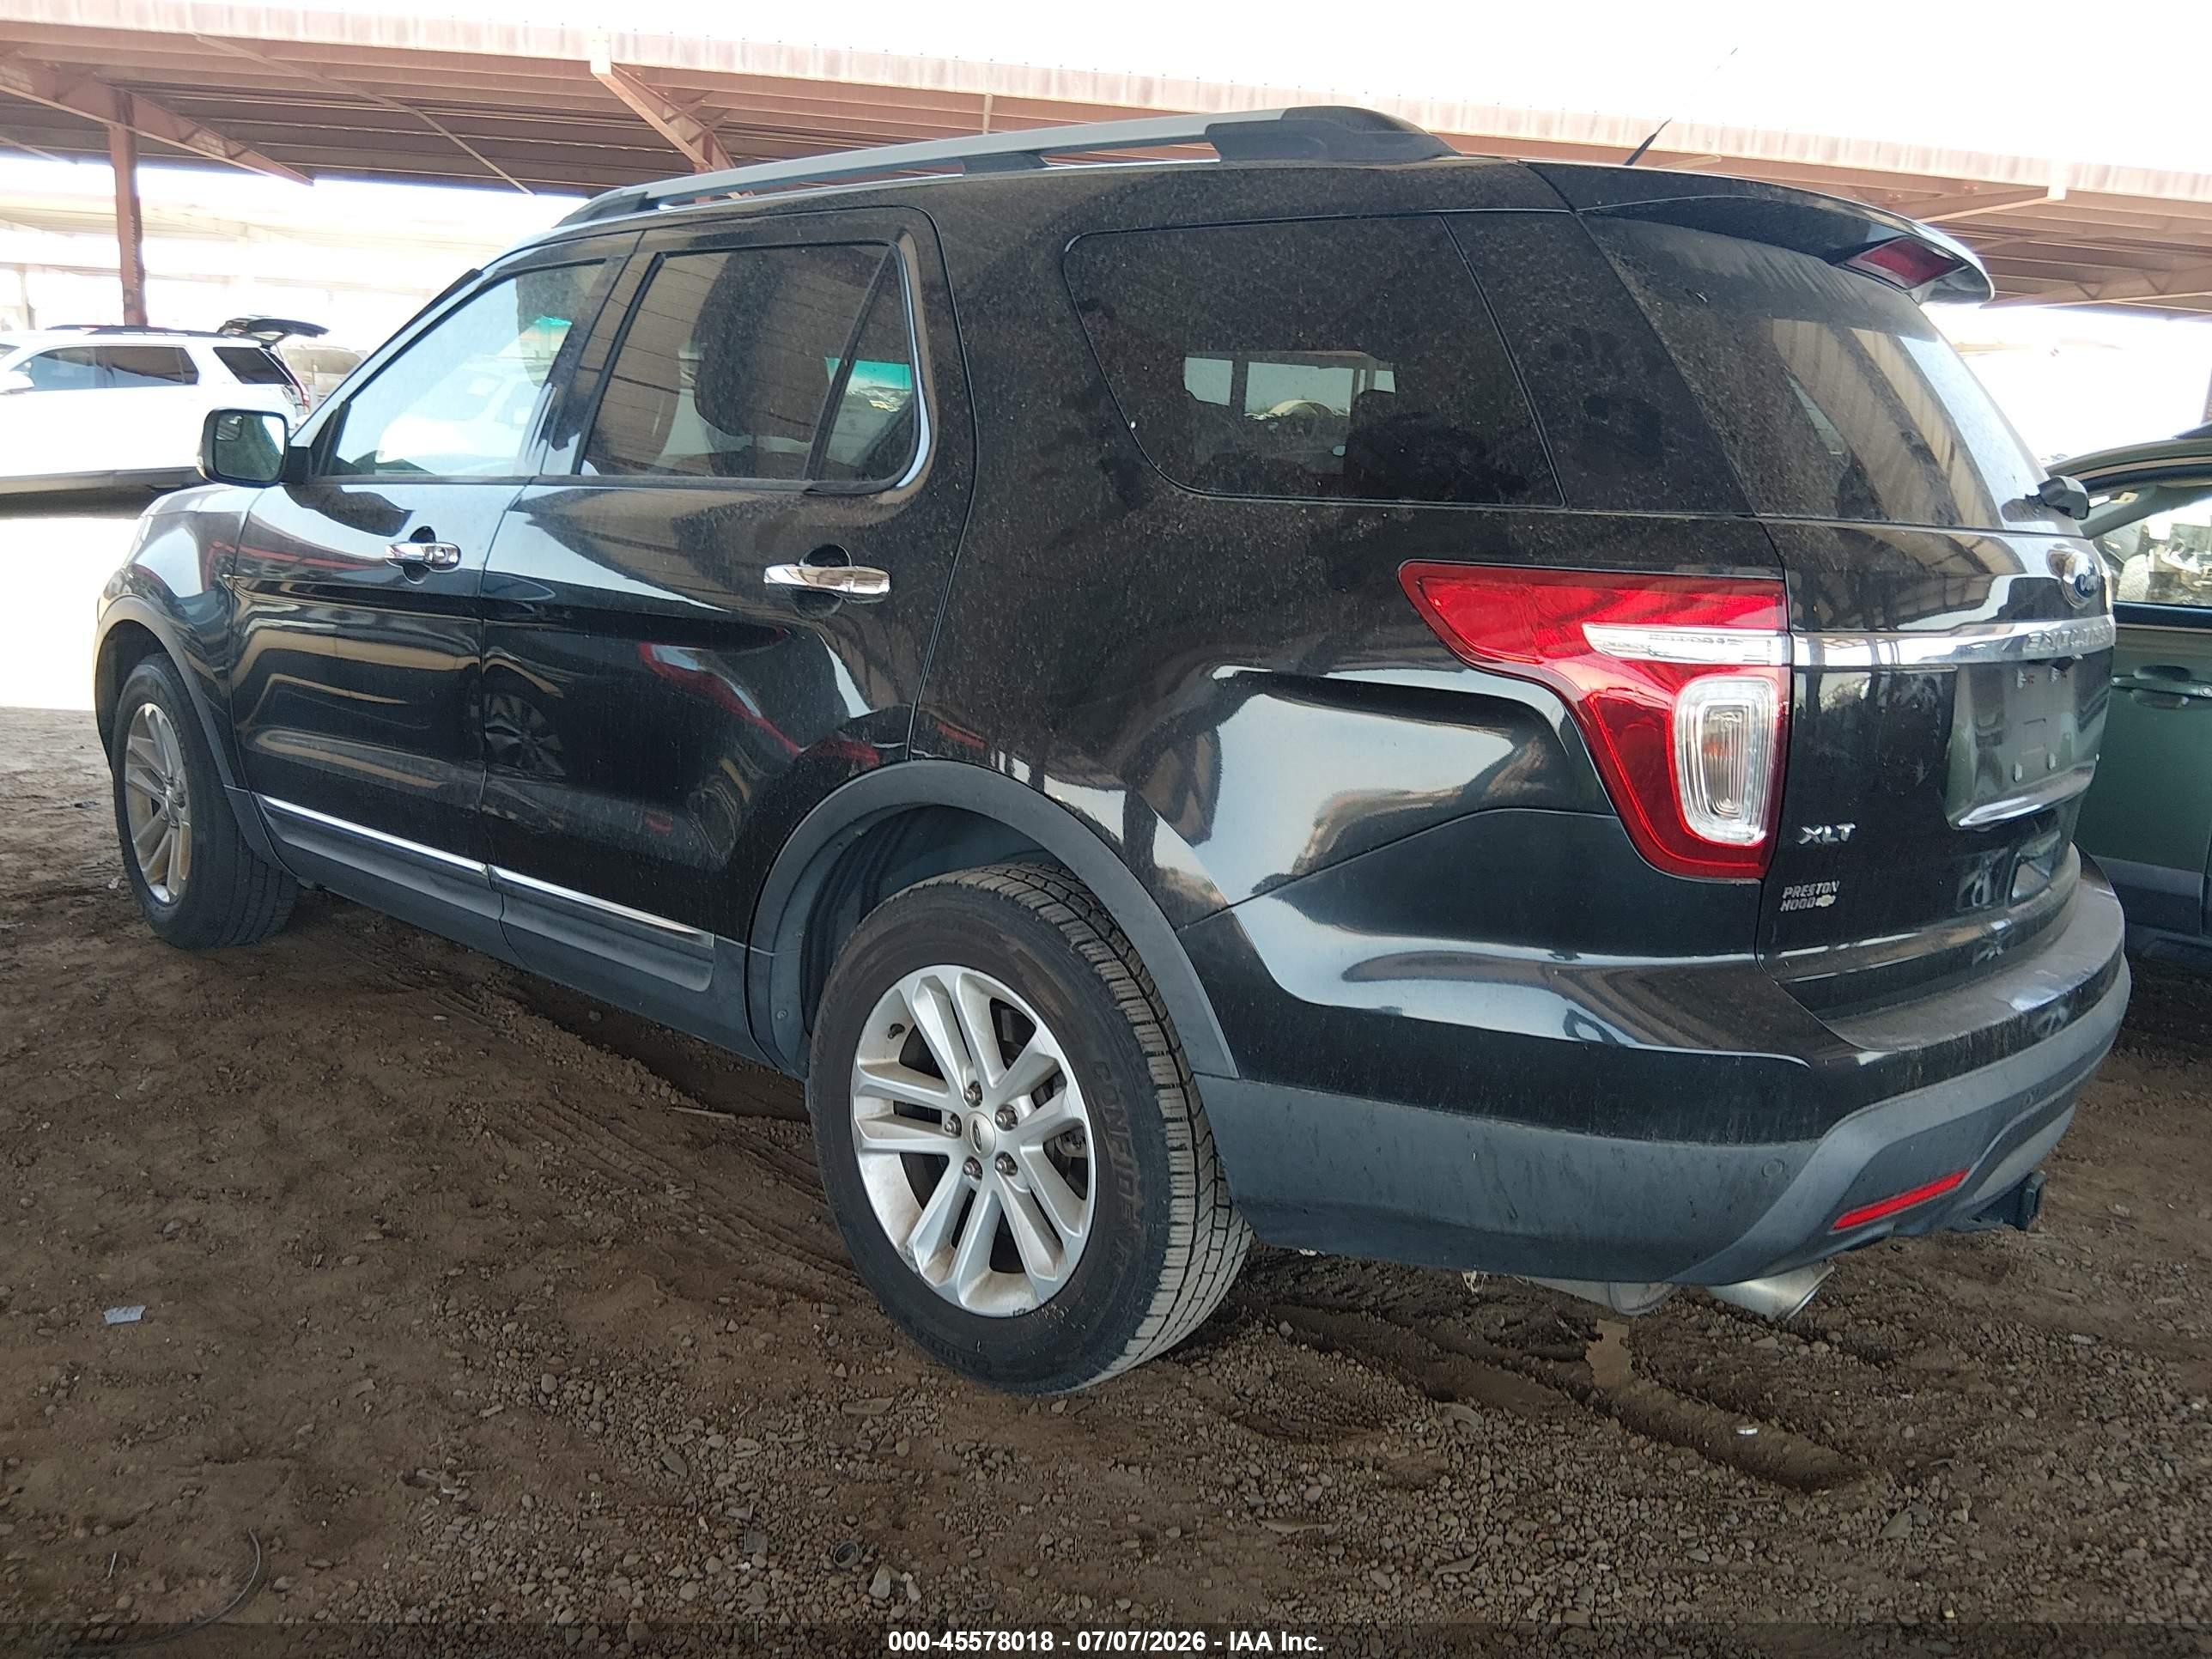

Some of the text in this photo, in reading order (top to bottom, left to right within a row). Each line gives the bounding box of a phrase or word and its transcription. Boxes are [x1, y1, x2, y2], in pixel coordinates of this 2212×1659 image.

[1798, 822, 1856, 845] XLT
[1782, 880, 1840, 899] PRESTON
[1779, 896, 1816, 913] HOOD
